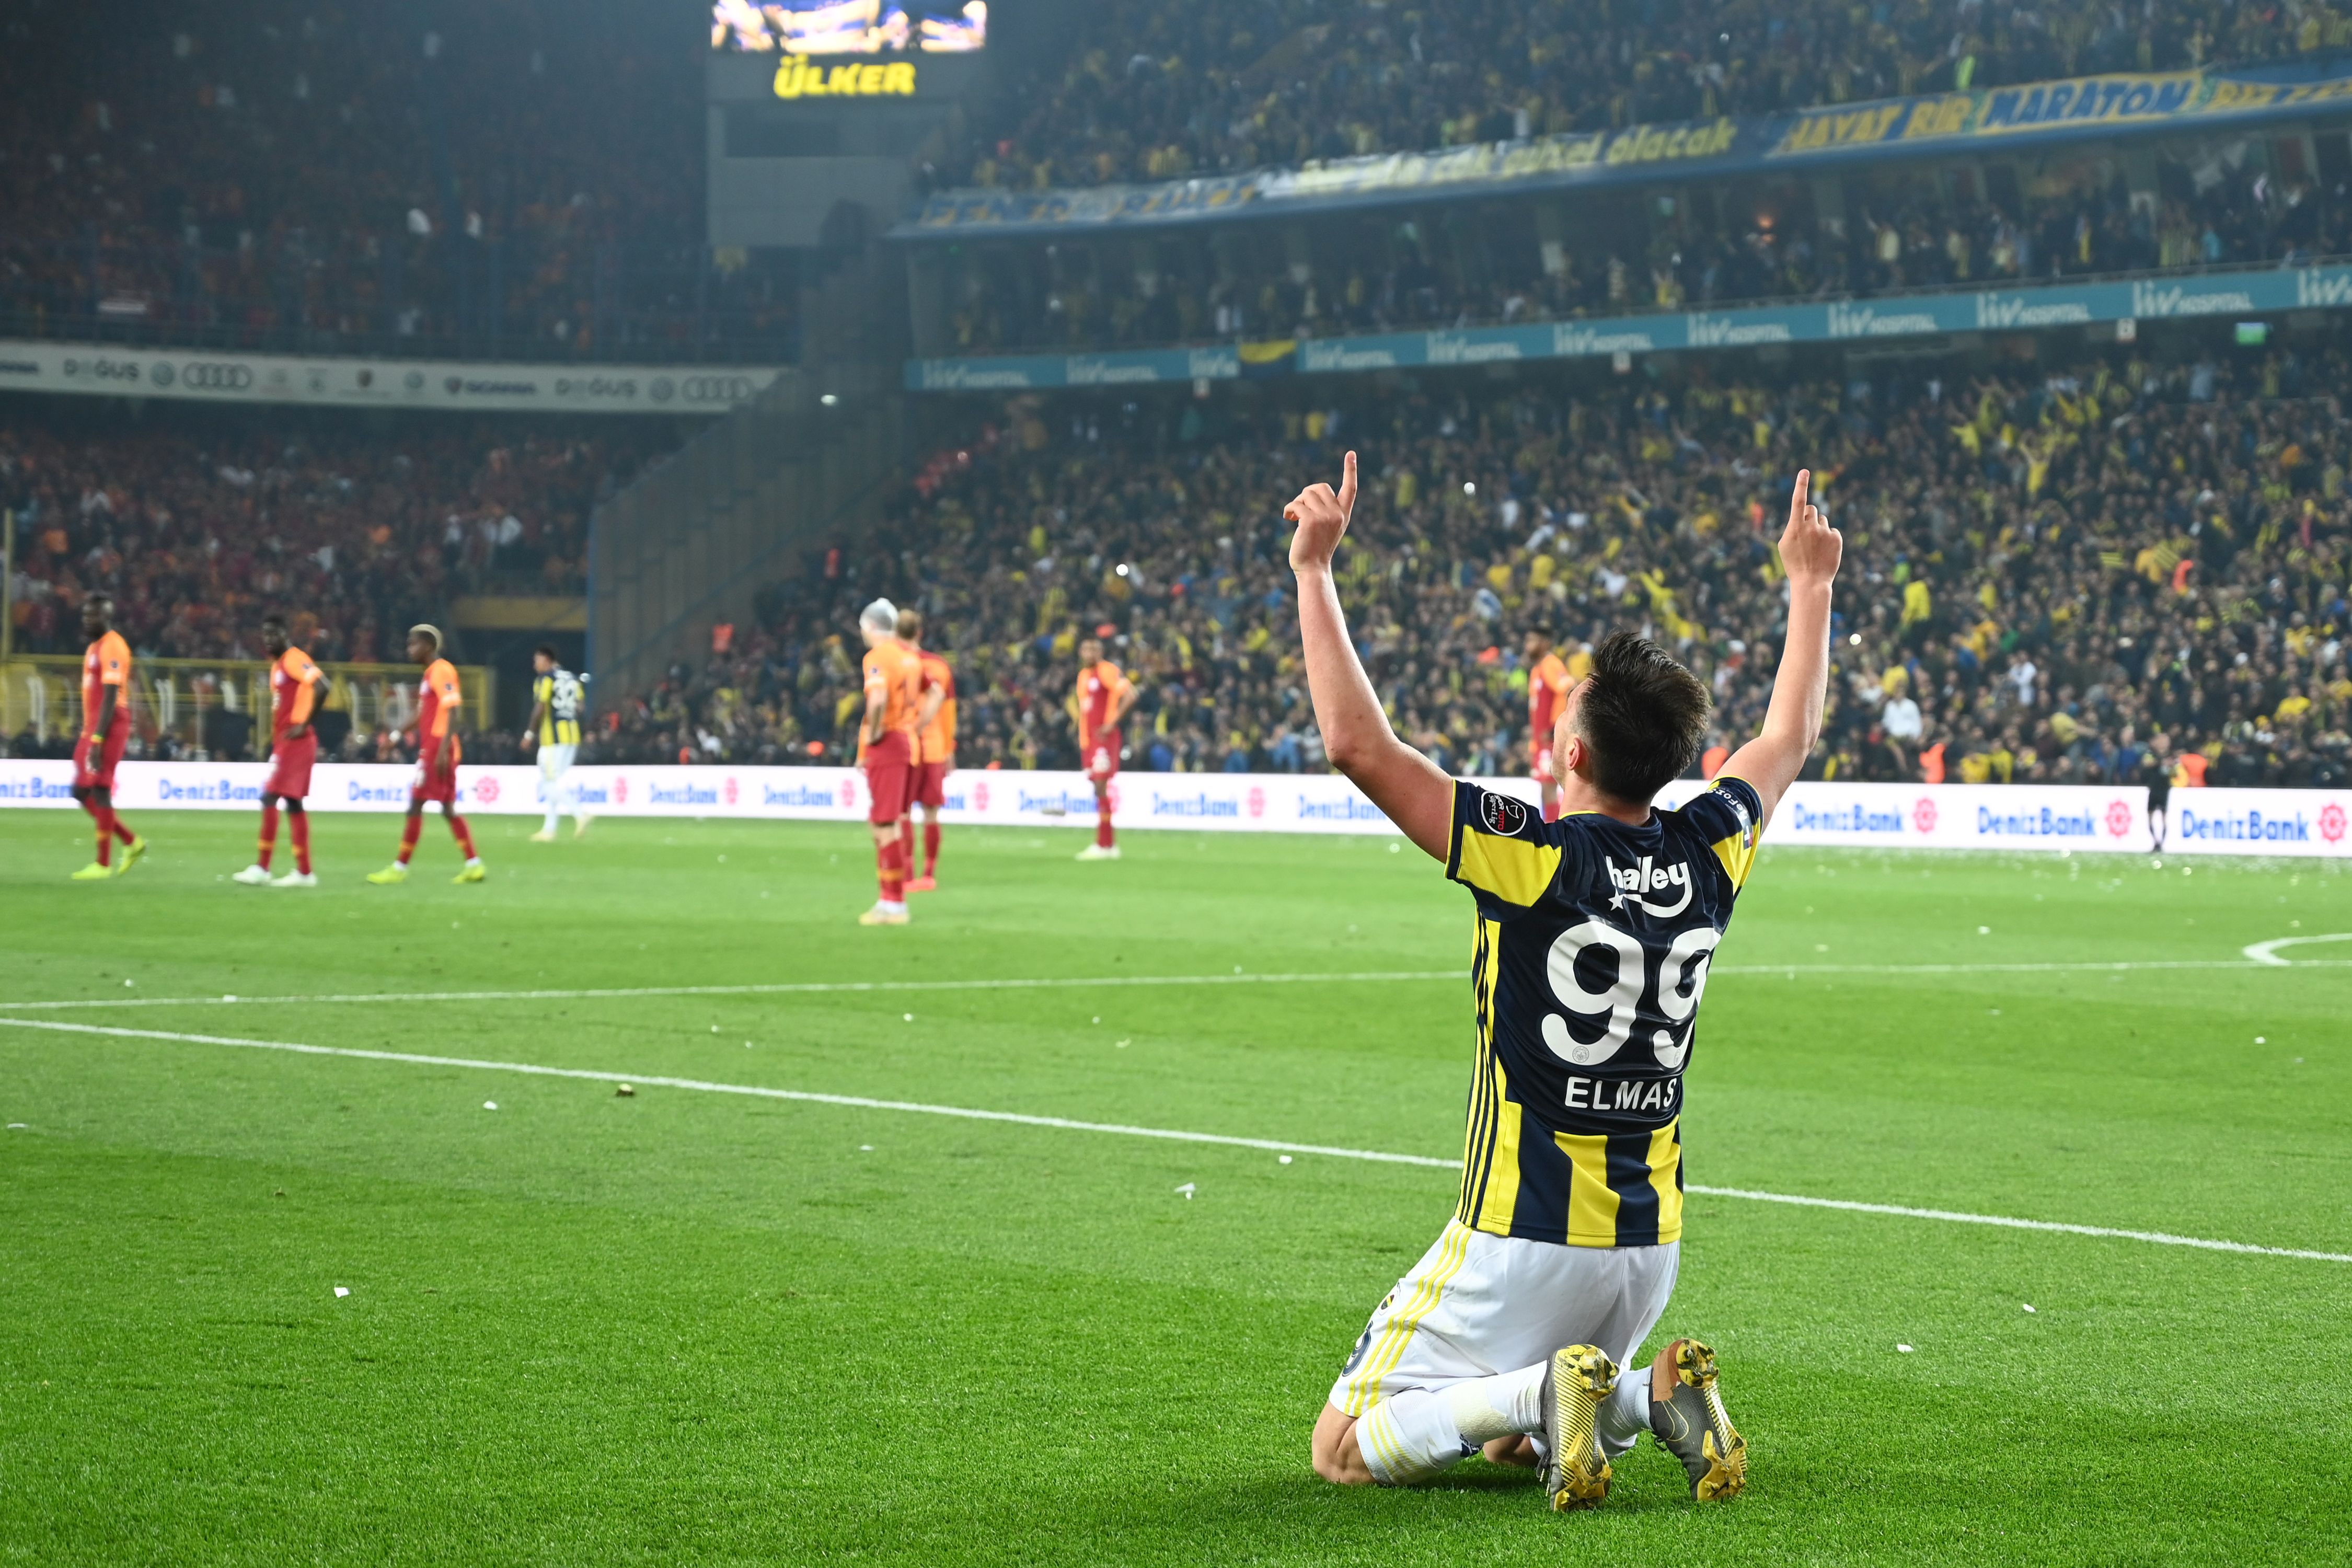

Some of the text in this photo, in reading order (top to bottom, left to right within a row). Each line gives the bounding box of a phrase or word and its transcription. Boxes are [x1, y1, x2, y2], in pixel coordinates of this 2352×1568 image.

[774, 52, 916, 99] ÜLKER
[1981, 78, 2193, 129] MARATON
[1605, 117, 1738, 165] olacak
[2132, 280, 2183, 319] liv
[2298, 267, 2349, 308] liv
[1688, 311, 1732, 347] liv
[1828, 296, 1874, 338] liv
[1976, 291, 2024, 329] liv
[1426, 330, 1468, 364] liv
[1554, 322, 1596, 355] liv
[160, 780, 261, 799] DenizBan
[1794, 803, 1903, 833] DenizBank
[1978, 806, 2096, 836] DenizBank
[2181, 809, 2309, 841] DenizBank
[1605, 855, 1692, 918] halley
[1541, 915, 1722, 1069] 99
[1564, 1076, 1677, 1110] ELMAS
